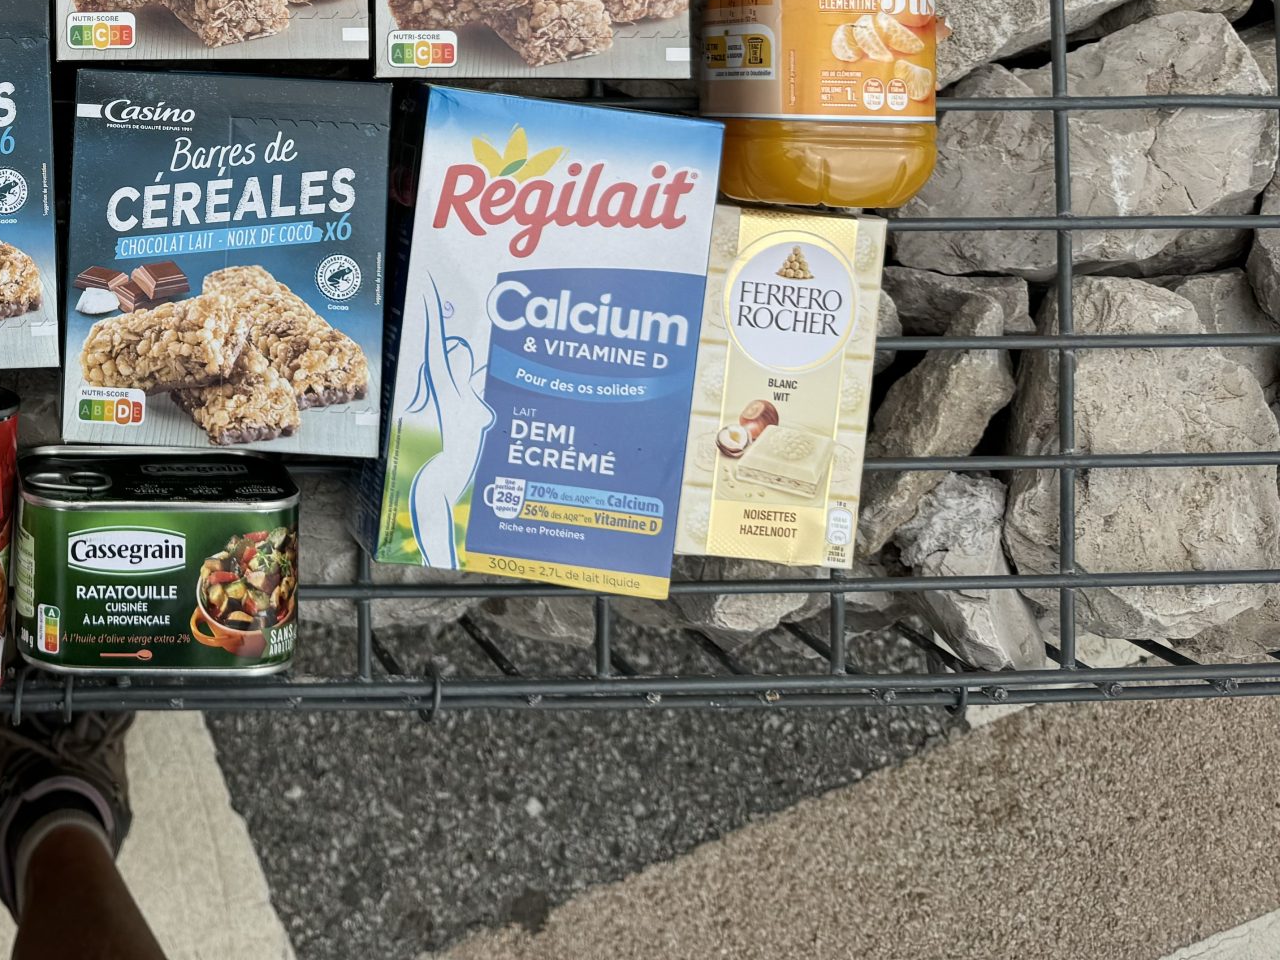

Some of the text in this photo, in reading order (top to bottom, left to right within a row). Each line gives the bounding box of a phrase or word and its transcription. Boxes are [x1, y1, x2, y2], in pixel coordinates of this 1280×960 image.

[104, 99, 195, 123] Casino
[169, 131, 298, 172] Barres de
[106, 167, 356, 232] CÉRÉALES
[120, 222, 313, 257] CHOCOLAT LAIT NOIX DE COCO
[323, 212, 352, 241] x6
[739, 280, 843, 312] FERRERO
[486, 280, 689, 346] Calcium
[737, 304, 840, 338] ROCHER
[524, 337, 669, 370] & VITAMINE D
[515, 368, 548, 388] Pour
[550, 377, 574, 392] des
[577, 383, 593, 395] os
[767, 377, 798, 390] BLANC
[773, 391, 790, 402] WIT
[513, 407, 536, 418] LAIT
[510, 419, 575, 445] DEMI
[507, 440, 617, 475] ÉCRÉMÉ
[495, 491, 520, 506] 28g
[530, 485, 558, 500] 70%
[607, 494, 659, 513] Calcium
[524, 504, 549, 518] 56%
[594, 512, 646, 531] Vitamine
[649, 519, 658, 532] D
[743, 508, 797, 523] NOISETTES
[499, 521, 585, 540] Riche en Protéines
[739, 524, 797, 538] HAZELNOOT
[71, 539, 184, 565] Cassegrain
[488, 557, 526, 575] 300g
[565, 568, 579, 582] de
[582, 570, 600, 584] lait
[602, 572, 641, 591] liquide
[76, 585, 178, 600] RATATOUILLE
[105, 601, 148, 612] CUISINÉE
[83, 613, 170, 627] À LA PROVENÇALE
[127, 634, 151, 646] vierge
[153, 634, 174, 643] extra
[176, 634, 191, 643] 2%
[271, 623, 293, 644] SANS
